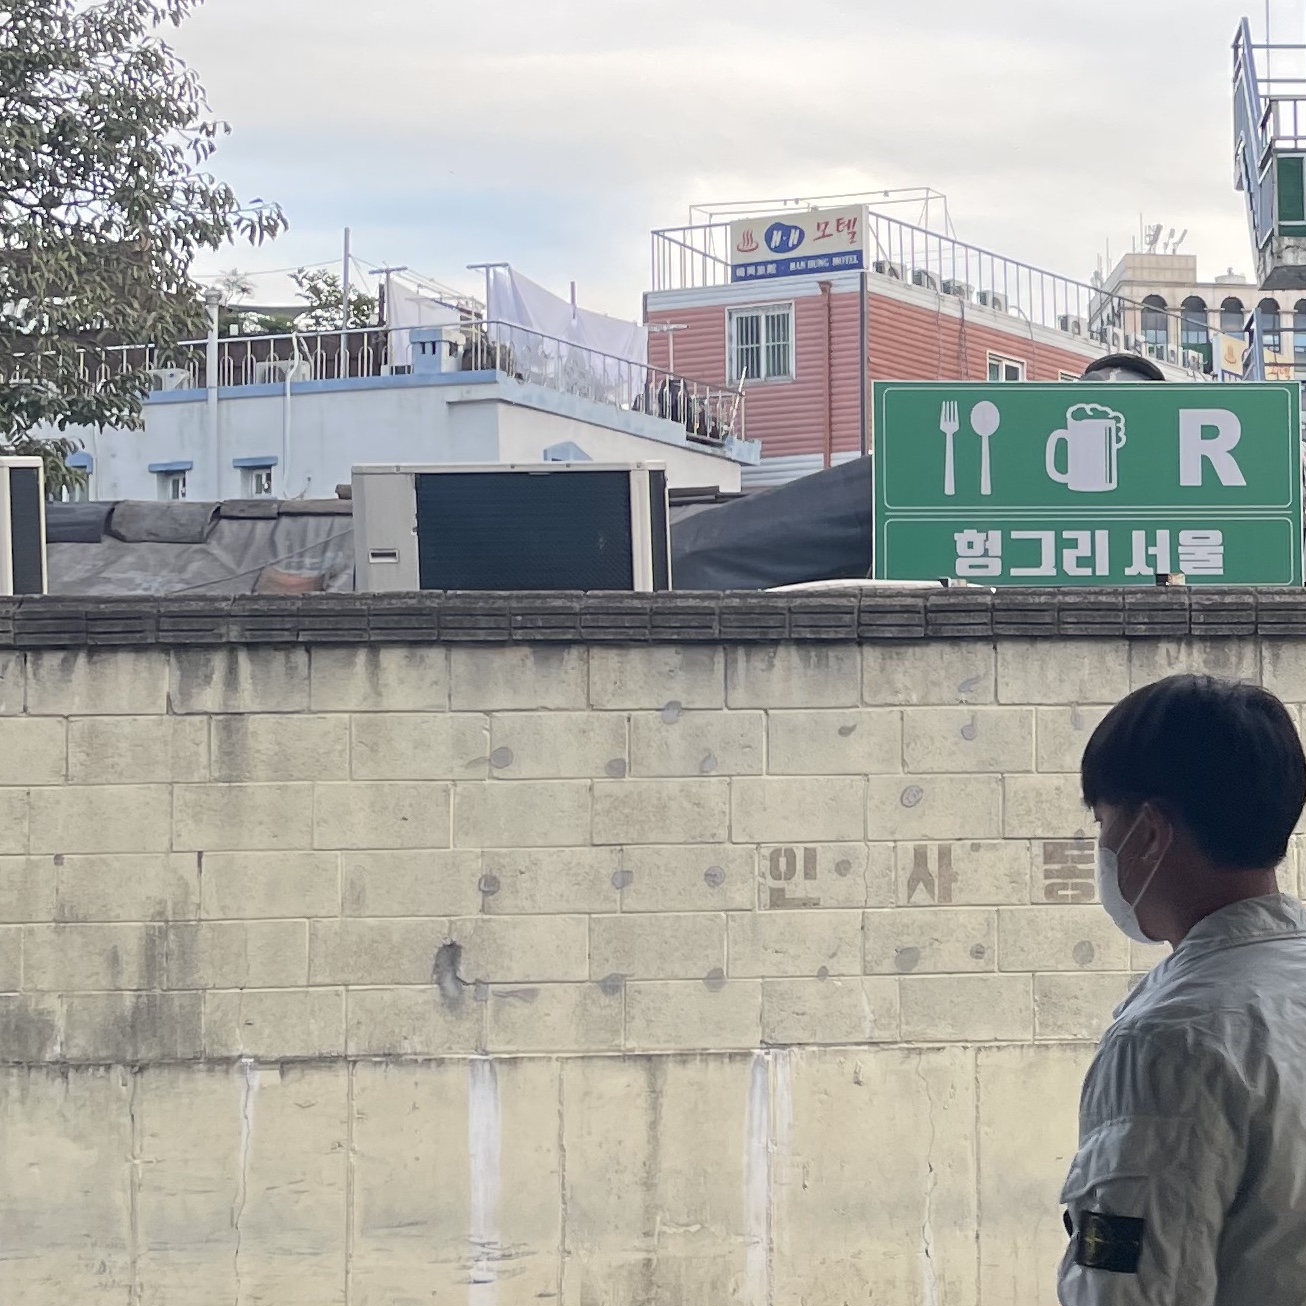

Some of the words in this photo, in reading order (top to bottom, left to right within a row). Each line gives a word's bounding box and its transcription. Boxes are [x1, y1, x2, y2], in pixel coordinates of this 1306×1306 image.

[813, 217, 858, 245] 모텔
[1178, 408, 1247, 487] R
[953, 529, 1110, 577] 헝그리
[1124, 529, 1225, 577] 서울
